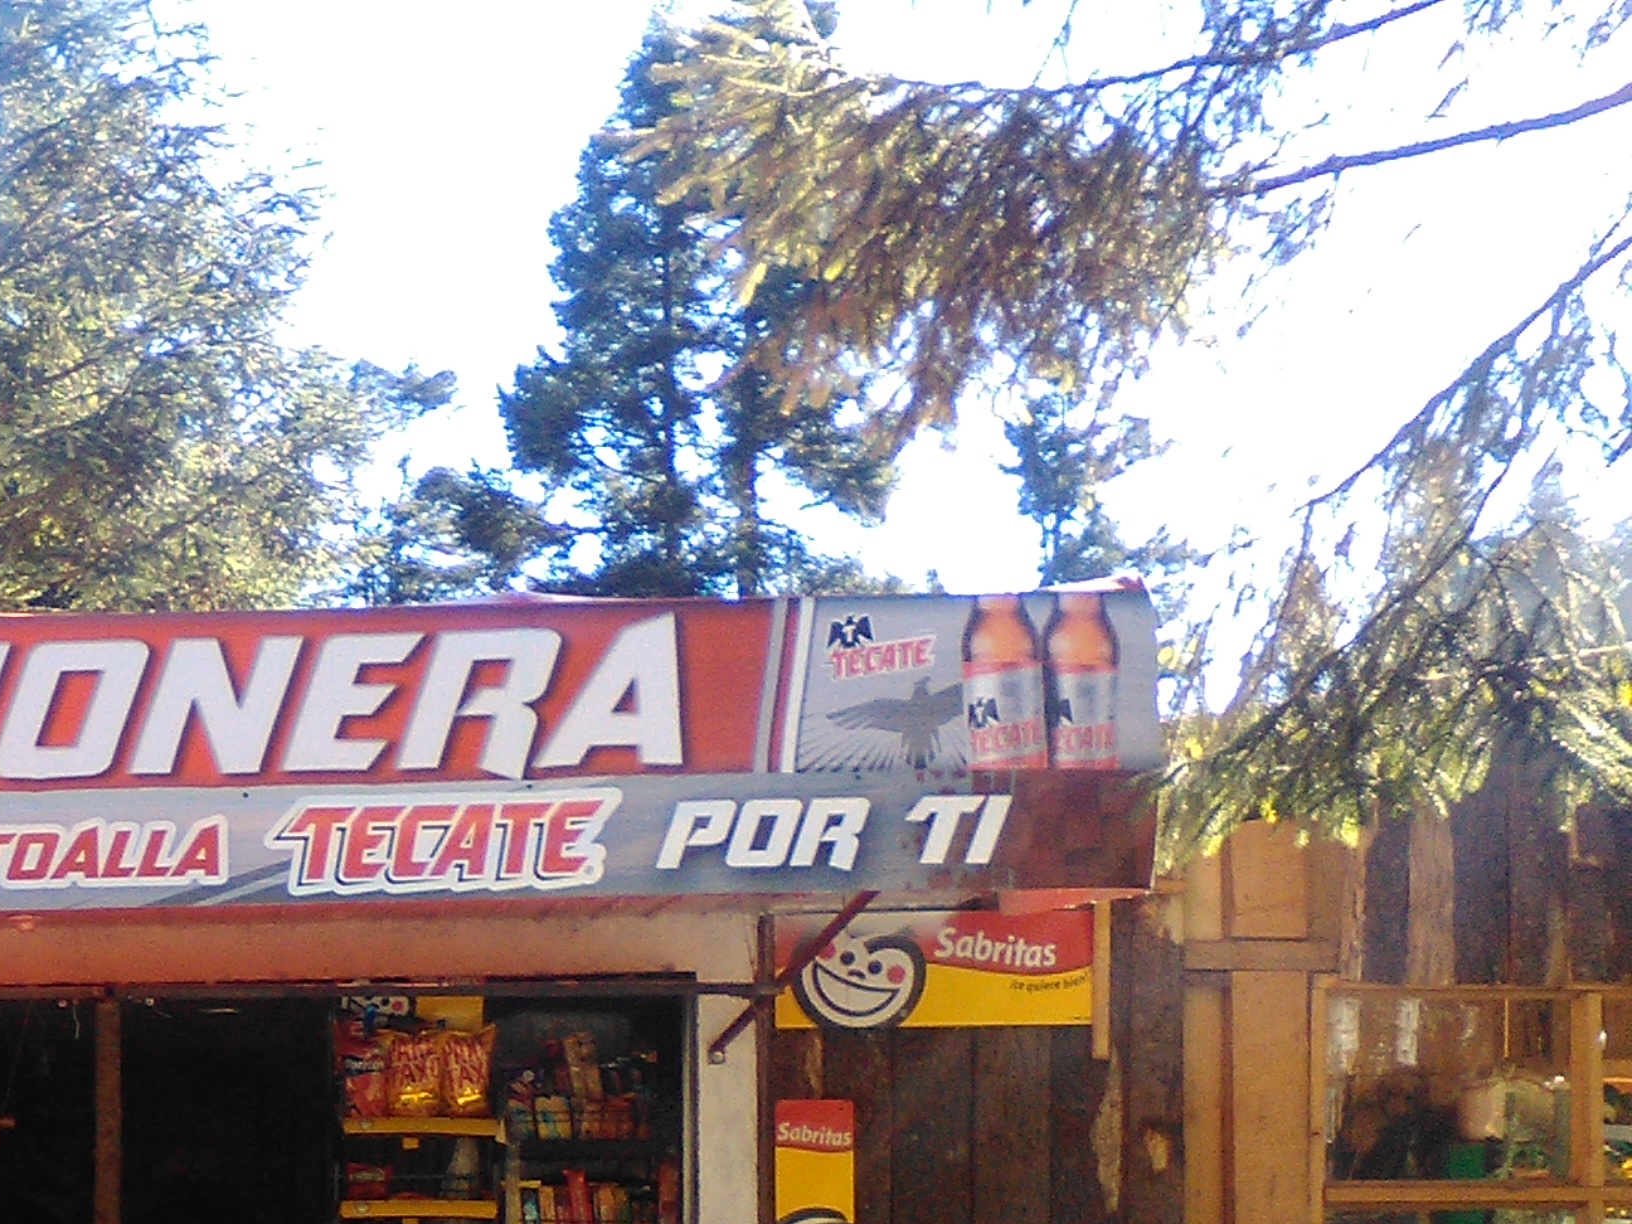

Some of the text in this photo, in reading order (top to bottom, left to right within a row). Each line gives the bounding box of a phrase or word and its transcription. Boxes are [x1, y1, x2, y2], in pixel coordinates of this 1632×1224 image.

[828, 635, 935, 680] TECATE
[274, 793, 610, 893] TECATE
[656, 797, 870, 873] POR
[906, 795, 1012, 867] TI
[934, 927, 1056, 967] Sabritas
[776, 1122, 852, 1146] Sabritas
